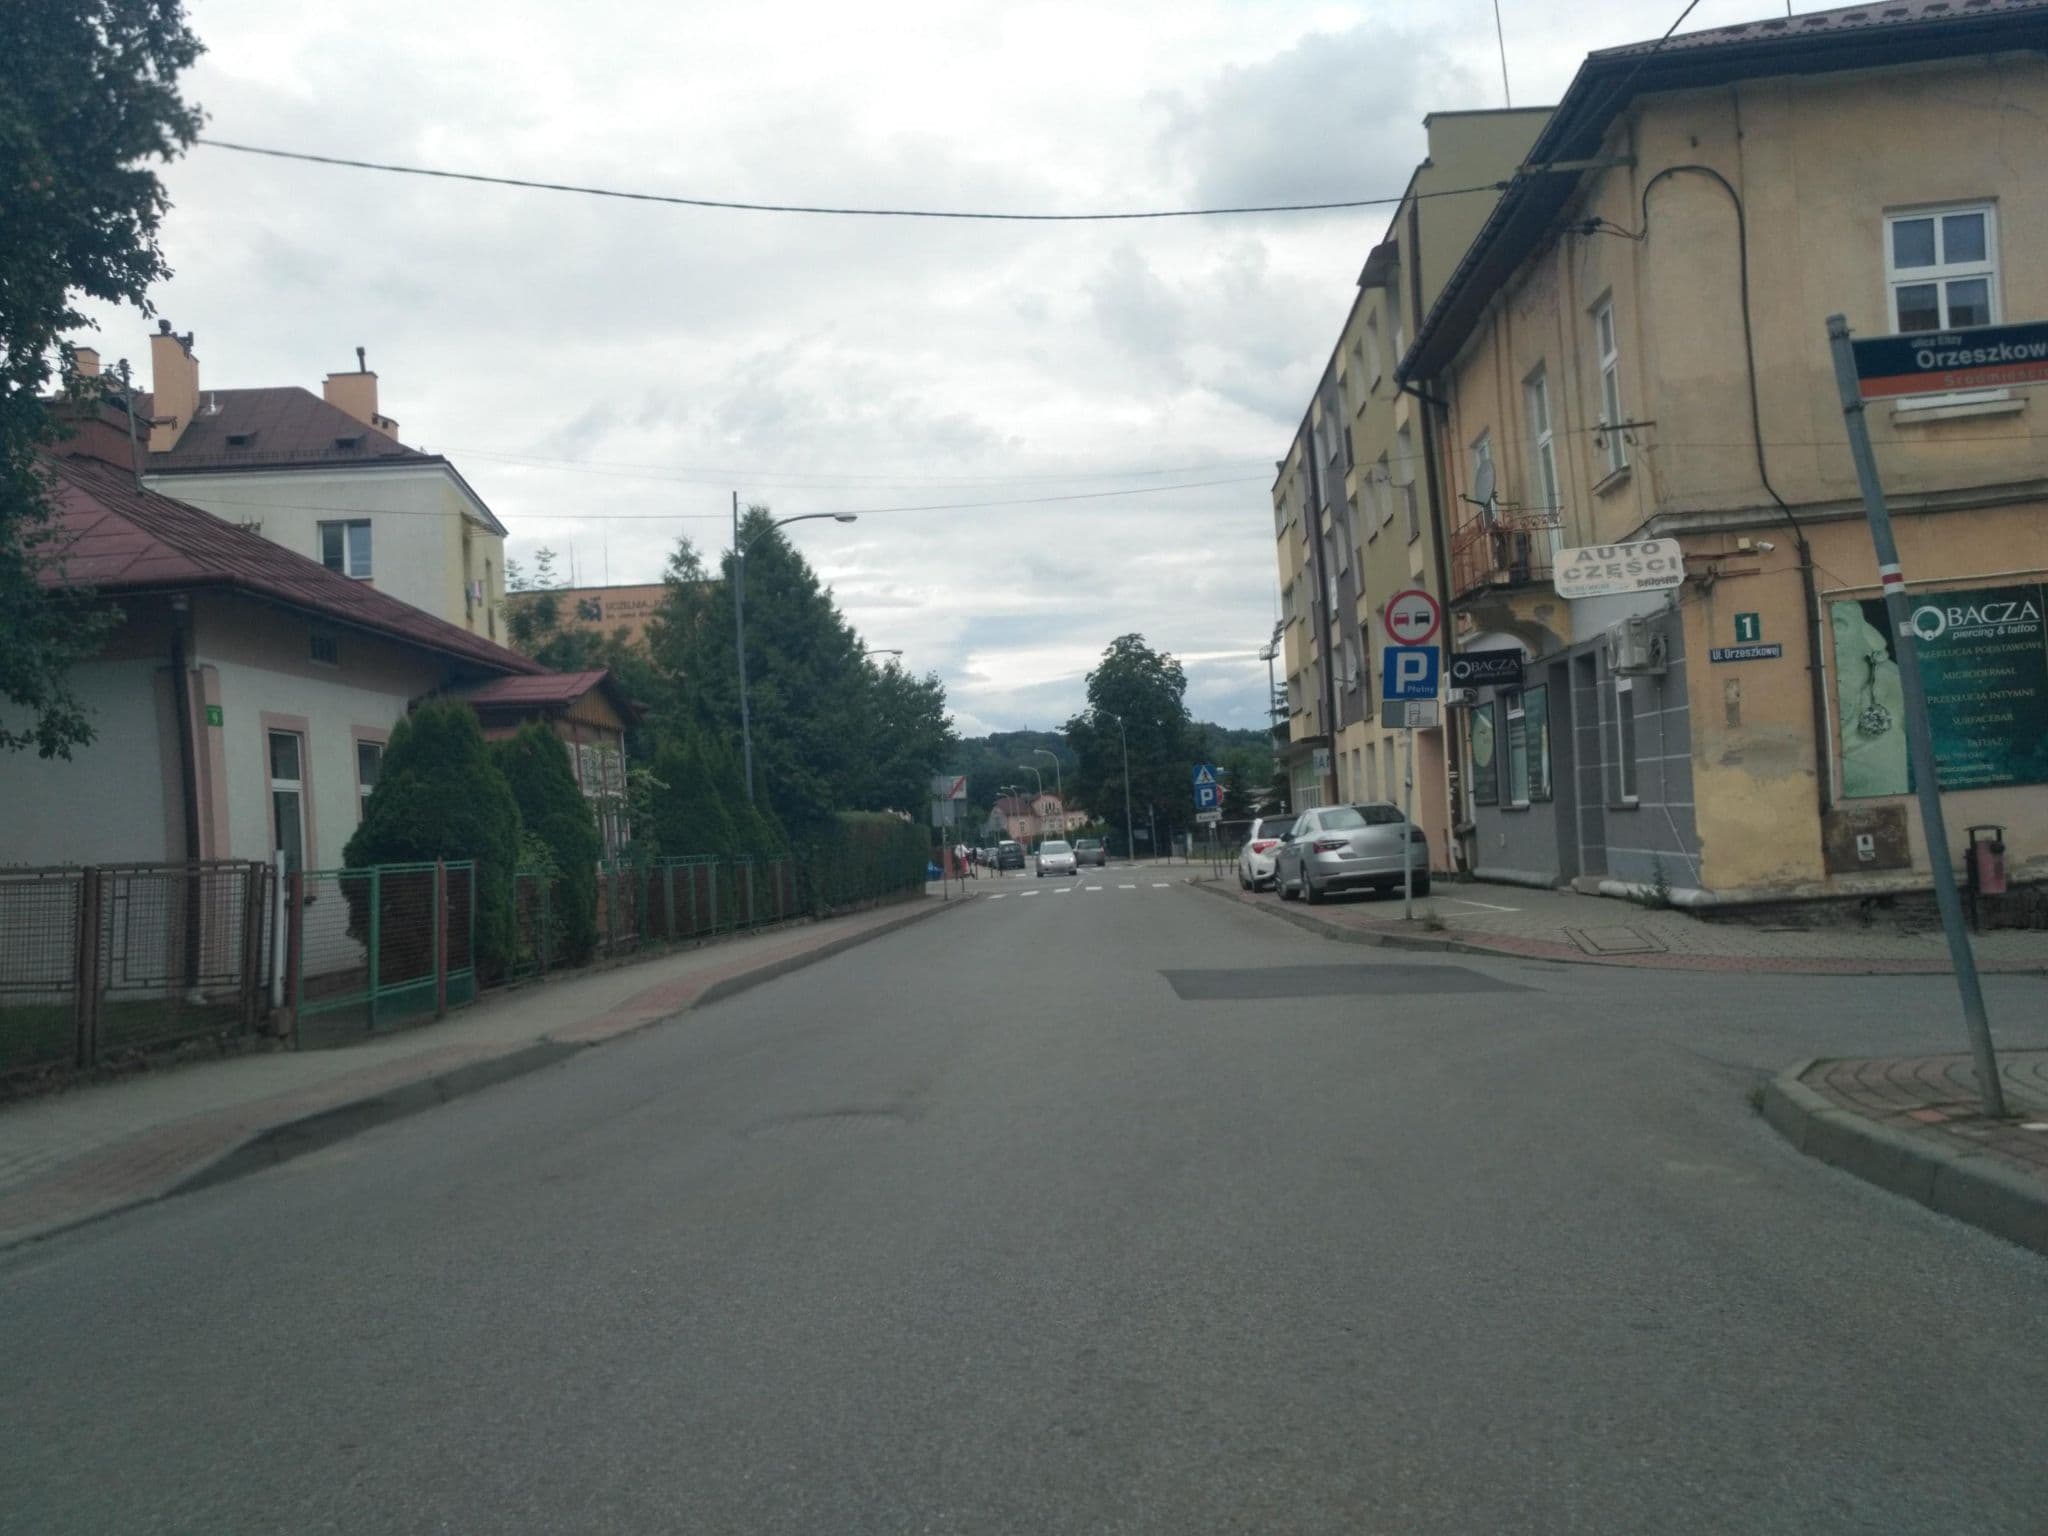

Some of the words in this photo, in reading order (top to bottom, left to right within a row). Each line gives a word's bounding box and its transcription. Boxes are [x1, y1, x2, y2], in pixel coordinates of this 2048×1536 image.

[1916, 341, 2048, 369] Orzeszkow
[1576, 542, 1660, 562] AUTO
[1563, 557, 1677, 581] CZĘŚCI
[1742, 617, 1752, 639] 1
[1952, 627, 1995, 640] piercing
[1997, 624, 2005, 636] &
[2007, 623, 2038, 635] tattoo
[1724, 647, 1780, 660] Orzeszkowej
[1396, 652, 1428, 694] P
[1200, 789, 1213, 806] P
